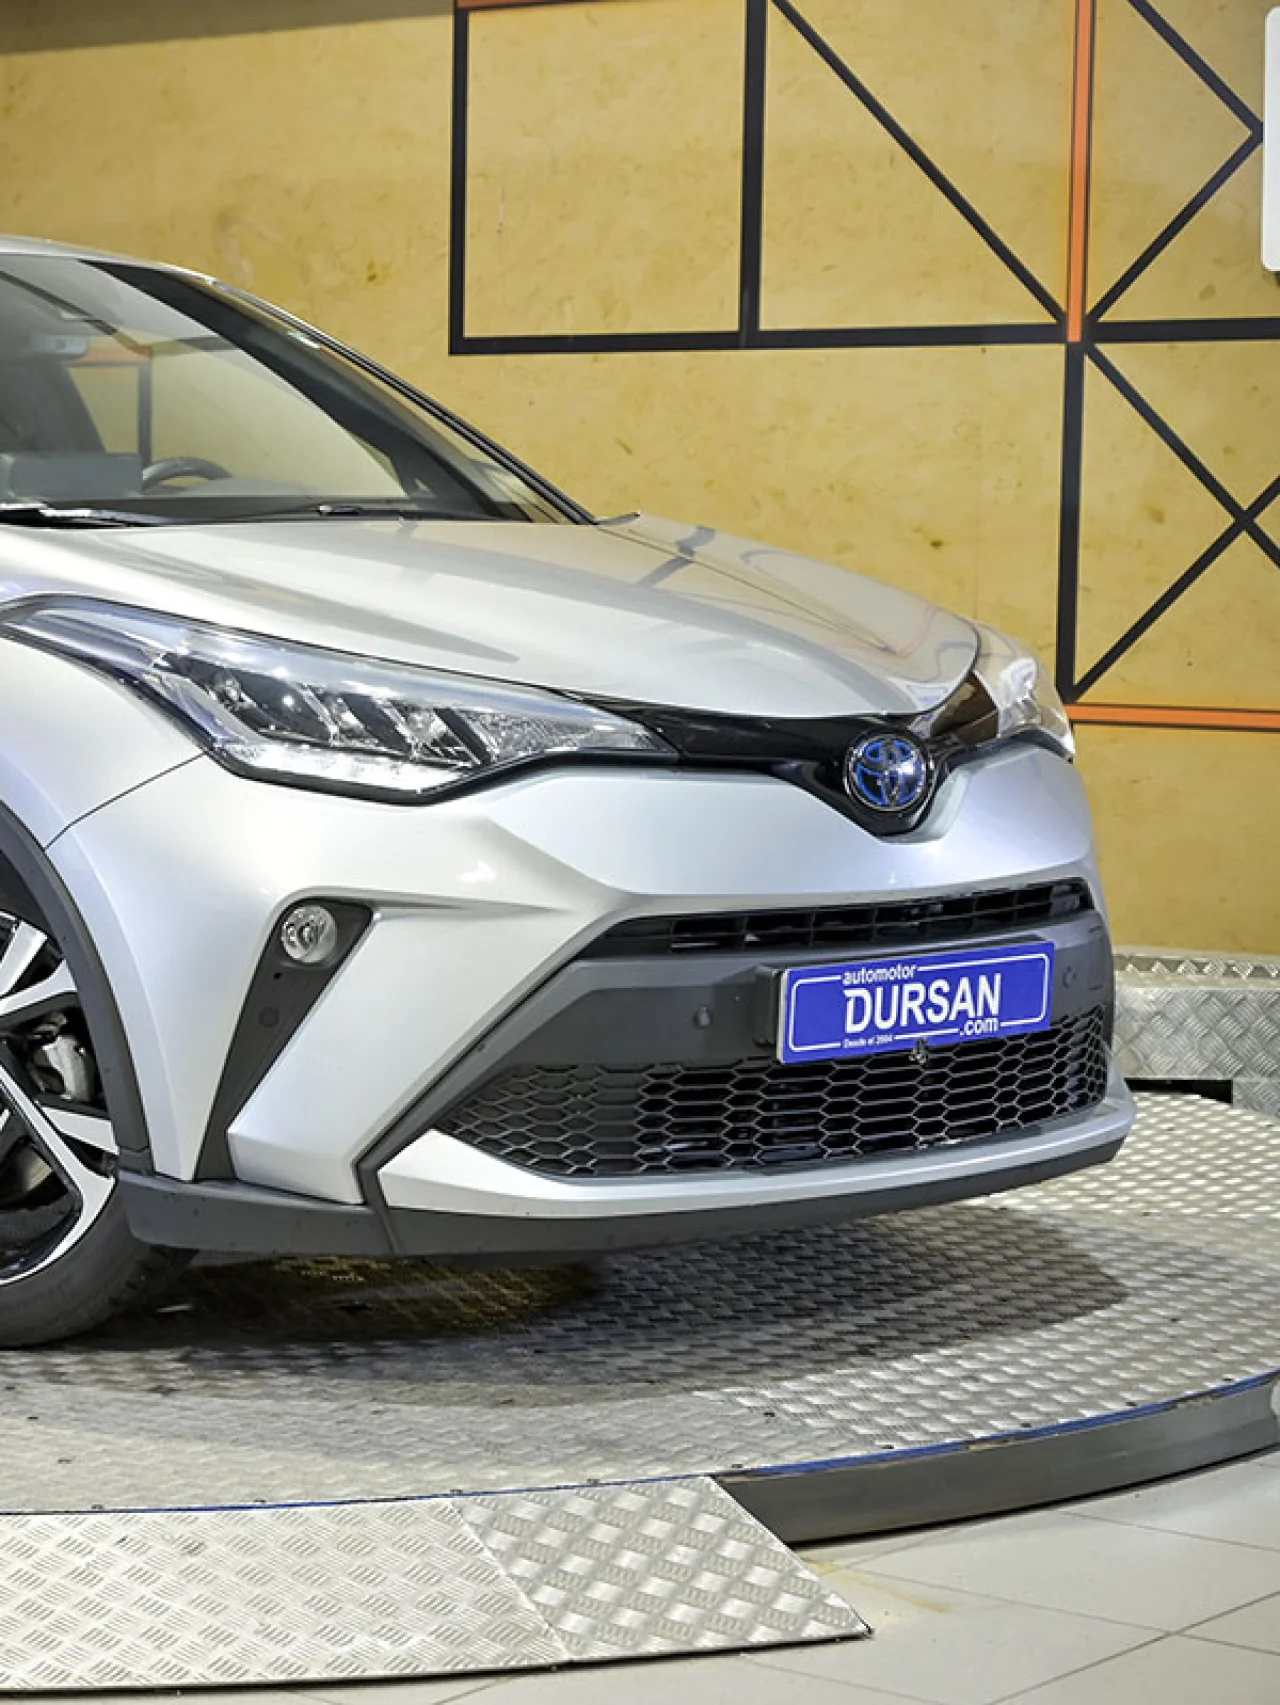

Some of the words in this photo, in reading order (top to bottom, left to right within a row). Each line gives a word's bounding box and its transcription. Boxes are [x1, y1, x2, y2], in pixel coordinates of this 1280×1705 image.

[843, 964, 916, 986] automotor
[843, 972, 1001, 1033] DURSAN
[960, 1018, 999, 1036] .com
